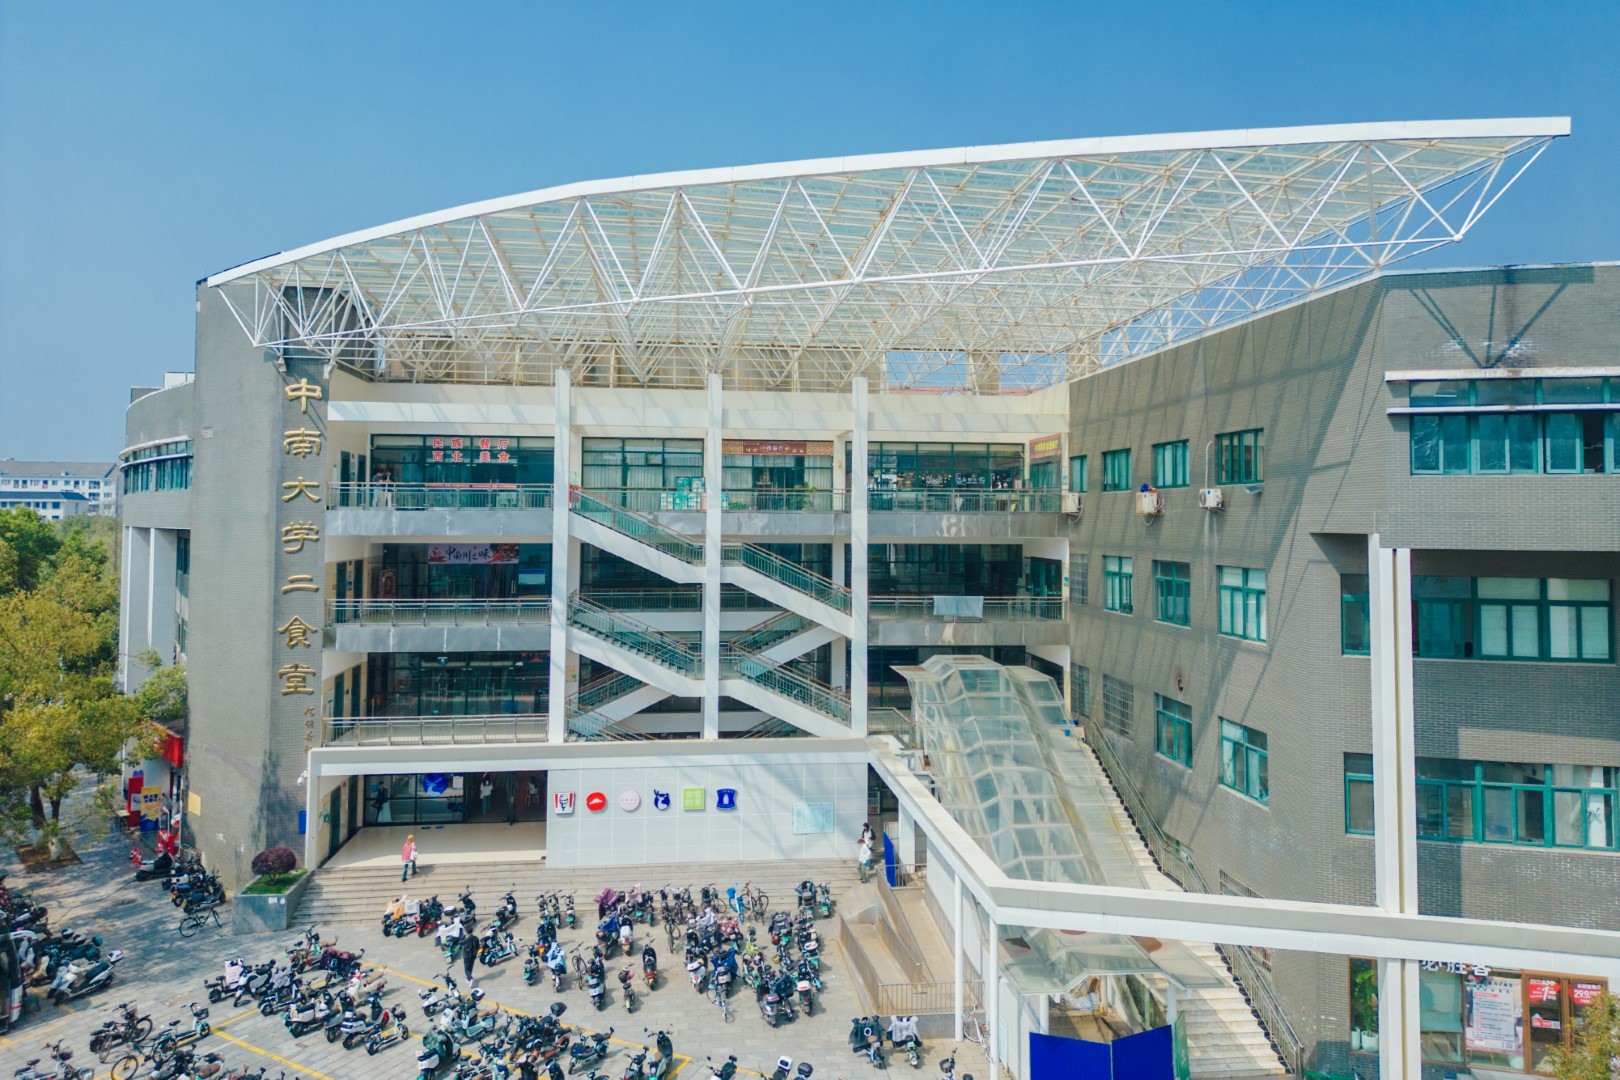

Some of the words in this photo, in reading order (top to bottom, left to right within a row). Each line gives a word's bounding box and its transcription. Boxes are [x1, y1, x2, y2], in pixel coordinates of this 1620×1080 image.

[432, 437, 510, 450] 民族餐厅
[432, 451, 510, 462] 西北美食
[277, 378, 323, 695] 中南大学二食堂
